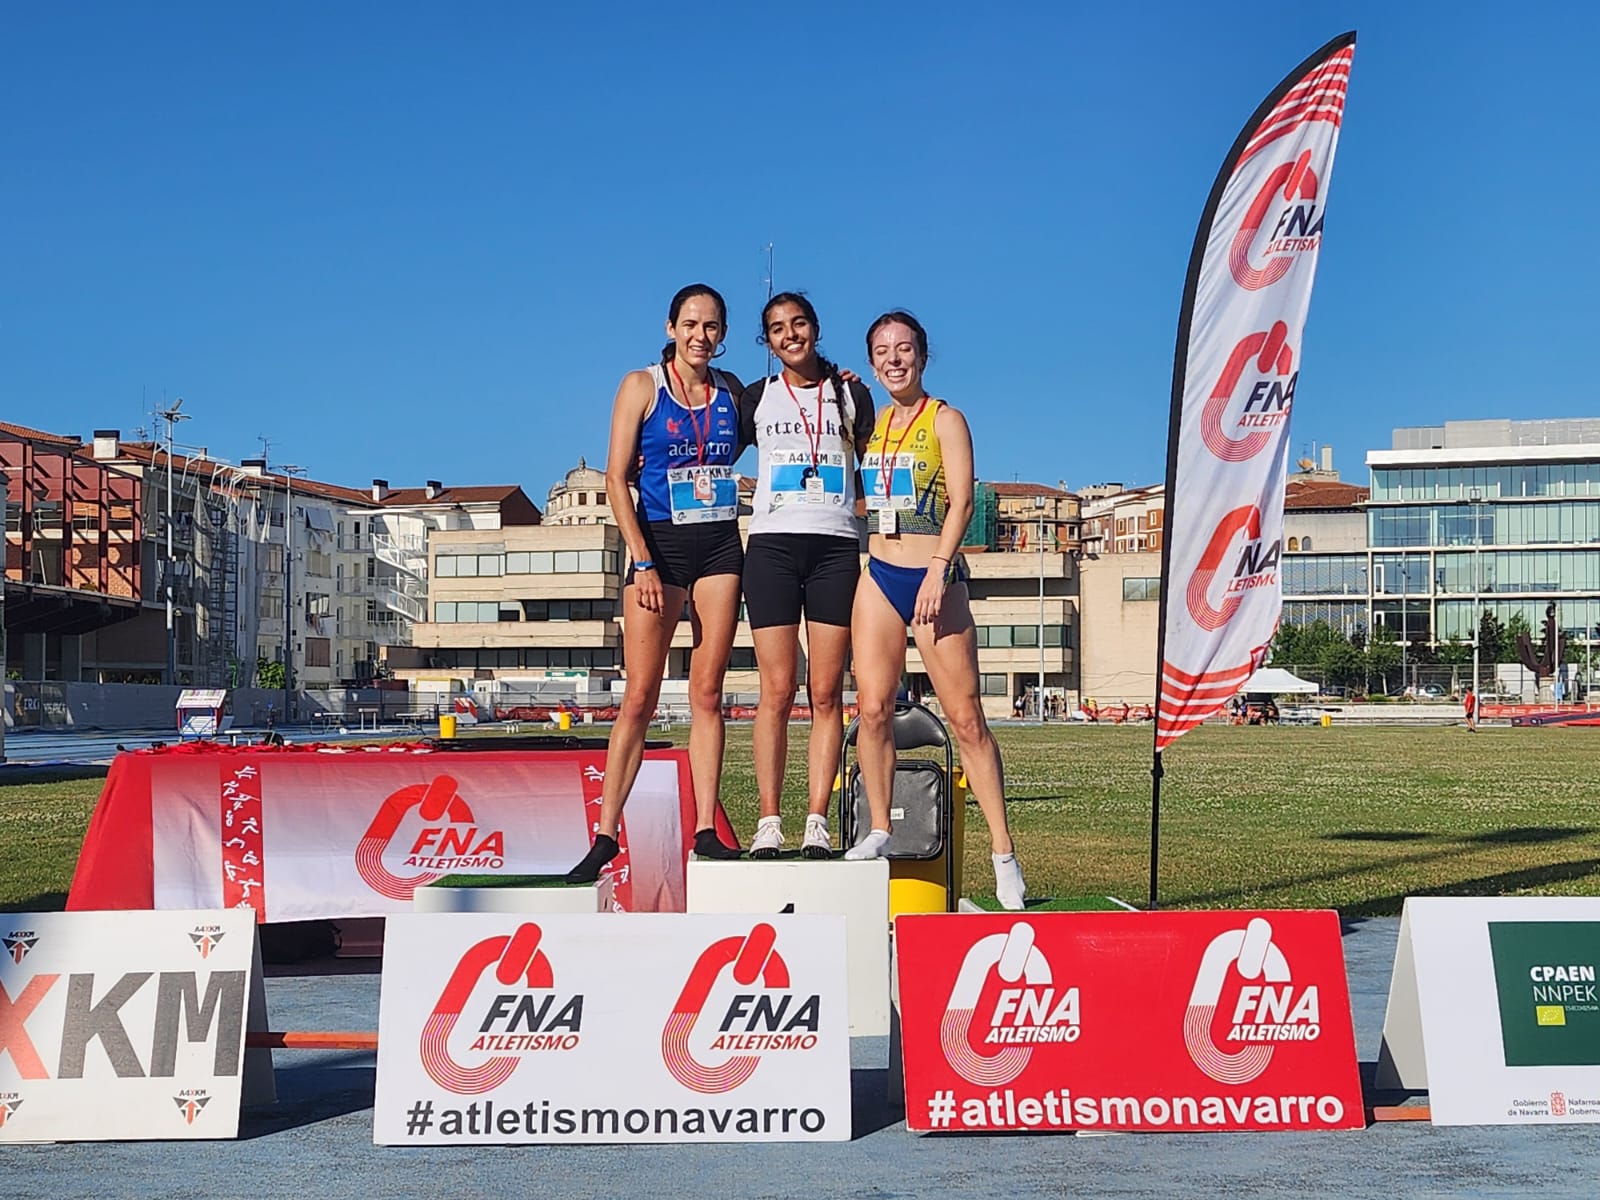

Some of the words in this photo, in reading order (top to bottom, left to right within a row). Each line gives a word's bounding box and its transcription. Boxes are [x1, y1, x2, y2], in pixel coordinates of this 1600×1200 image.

[1262, 238, 1322, 257] ATLETISM
[1243, 371, 1298, 413] FNA
[916, 428, 928, 442] G
[1236, 539, 1281, 577] NA
[409, 827, 504, 857] FNA
[403, 855, 504, 869] ATLETISMO
[1530, 966, 1595, 981] CPAEN
[1232, 985, 1320, 1024] FNA
[1533, 985, 1599, 1002] NNPEK
[479, 994, 585, 1033] FNA
[718, 994, 821, 1033] FNA
[991, 987, 1081, 1025] FNA
[469, 1034, 580, 1051] ATLETISMO
[710, 1034, 818, 1051] ATLETISMO
[984, 1026, 1081, 1044] ATLETISMO
[1226, 1024, 1320, 1041] ATLETISMO
[406, 1101, 826, 1137] #atletismonavarro
[928, 1089, 1344, 1128] #atletismonavarro
